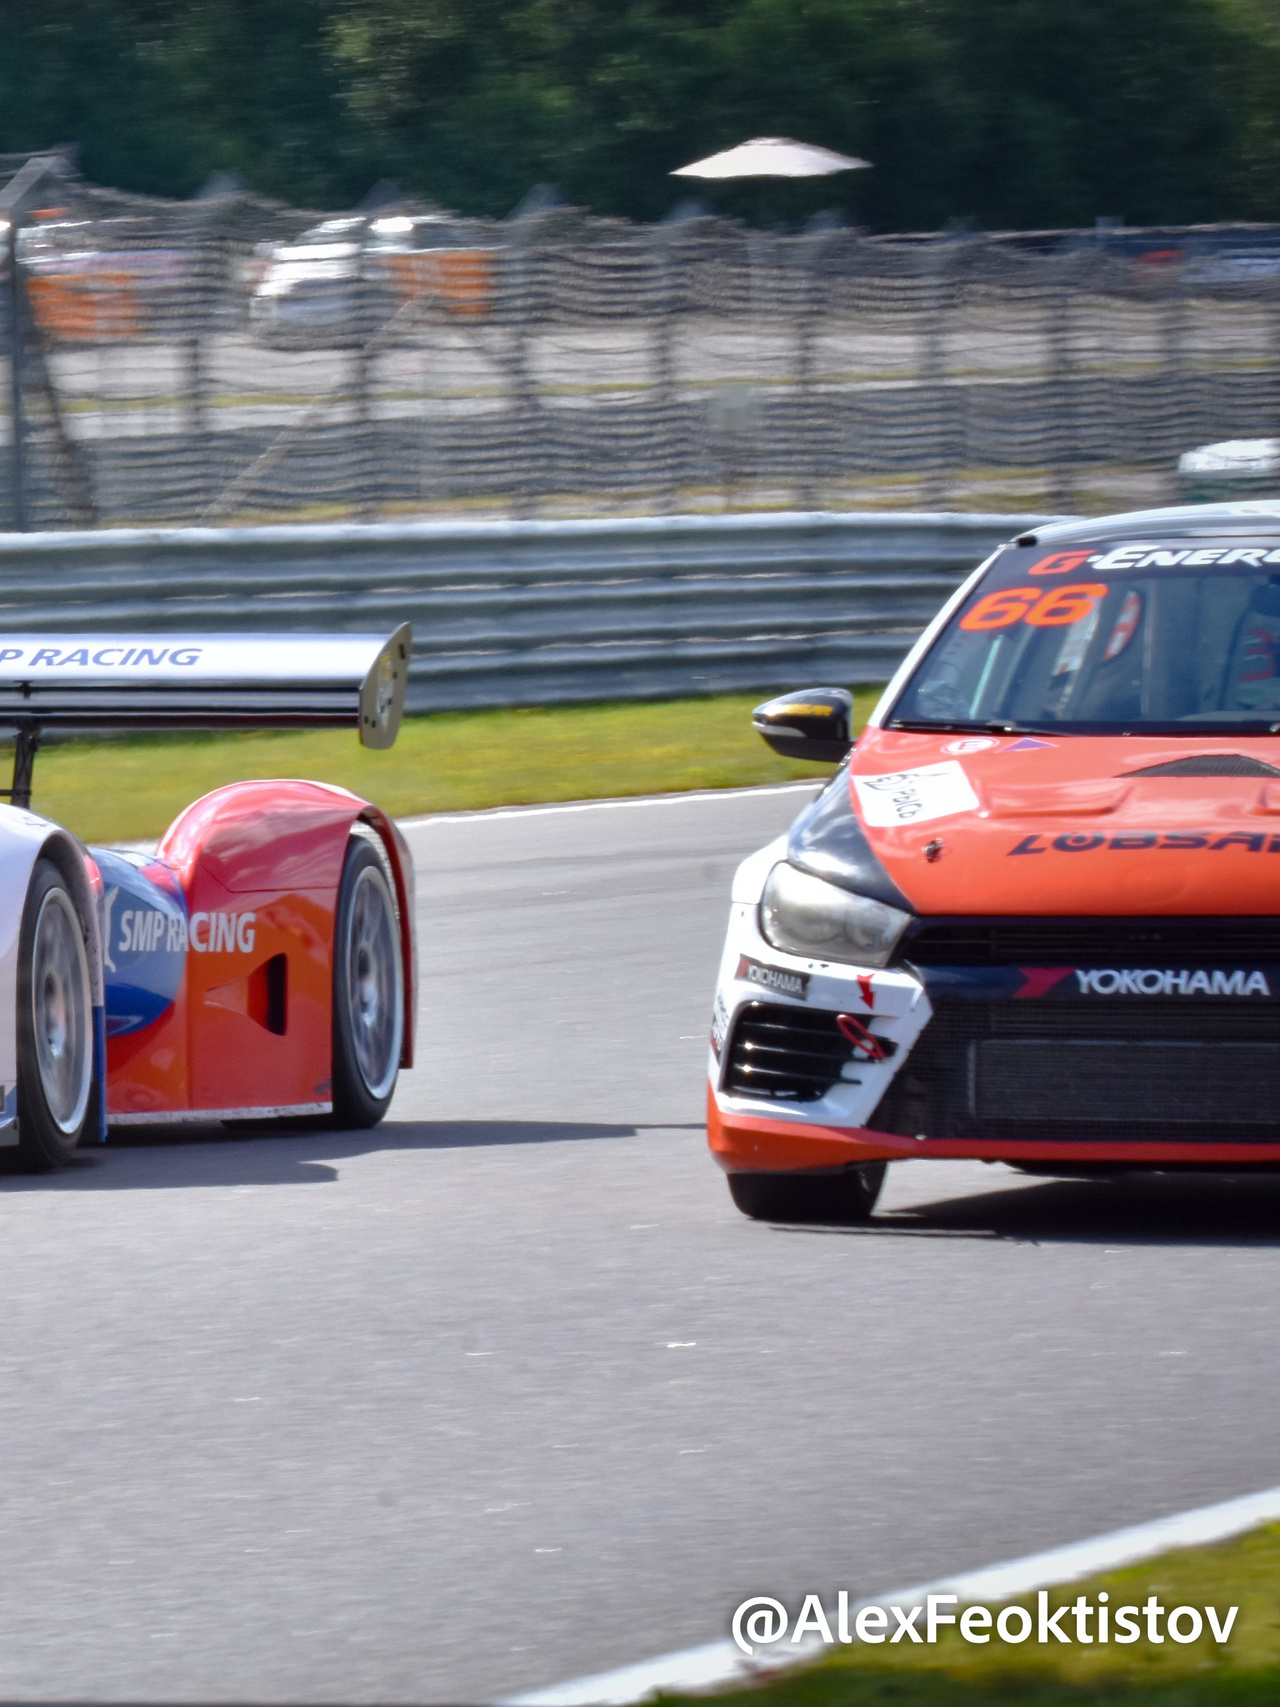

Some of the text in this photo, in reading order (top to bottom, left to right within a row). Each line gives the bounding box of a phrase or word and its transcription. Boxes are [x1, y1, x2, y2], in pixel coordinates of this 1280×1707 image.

[959, 583, 1109, 631] 66
[28, 648, 204, 667] RACING
[118, 910, 256, 953] SMP RACING
[1075, 969, 1271, 995] YOKOHAMA
